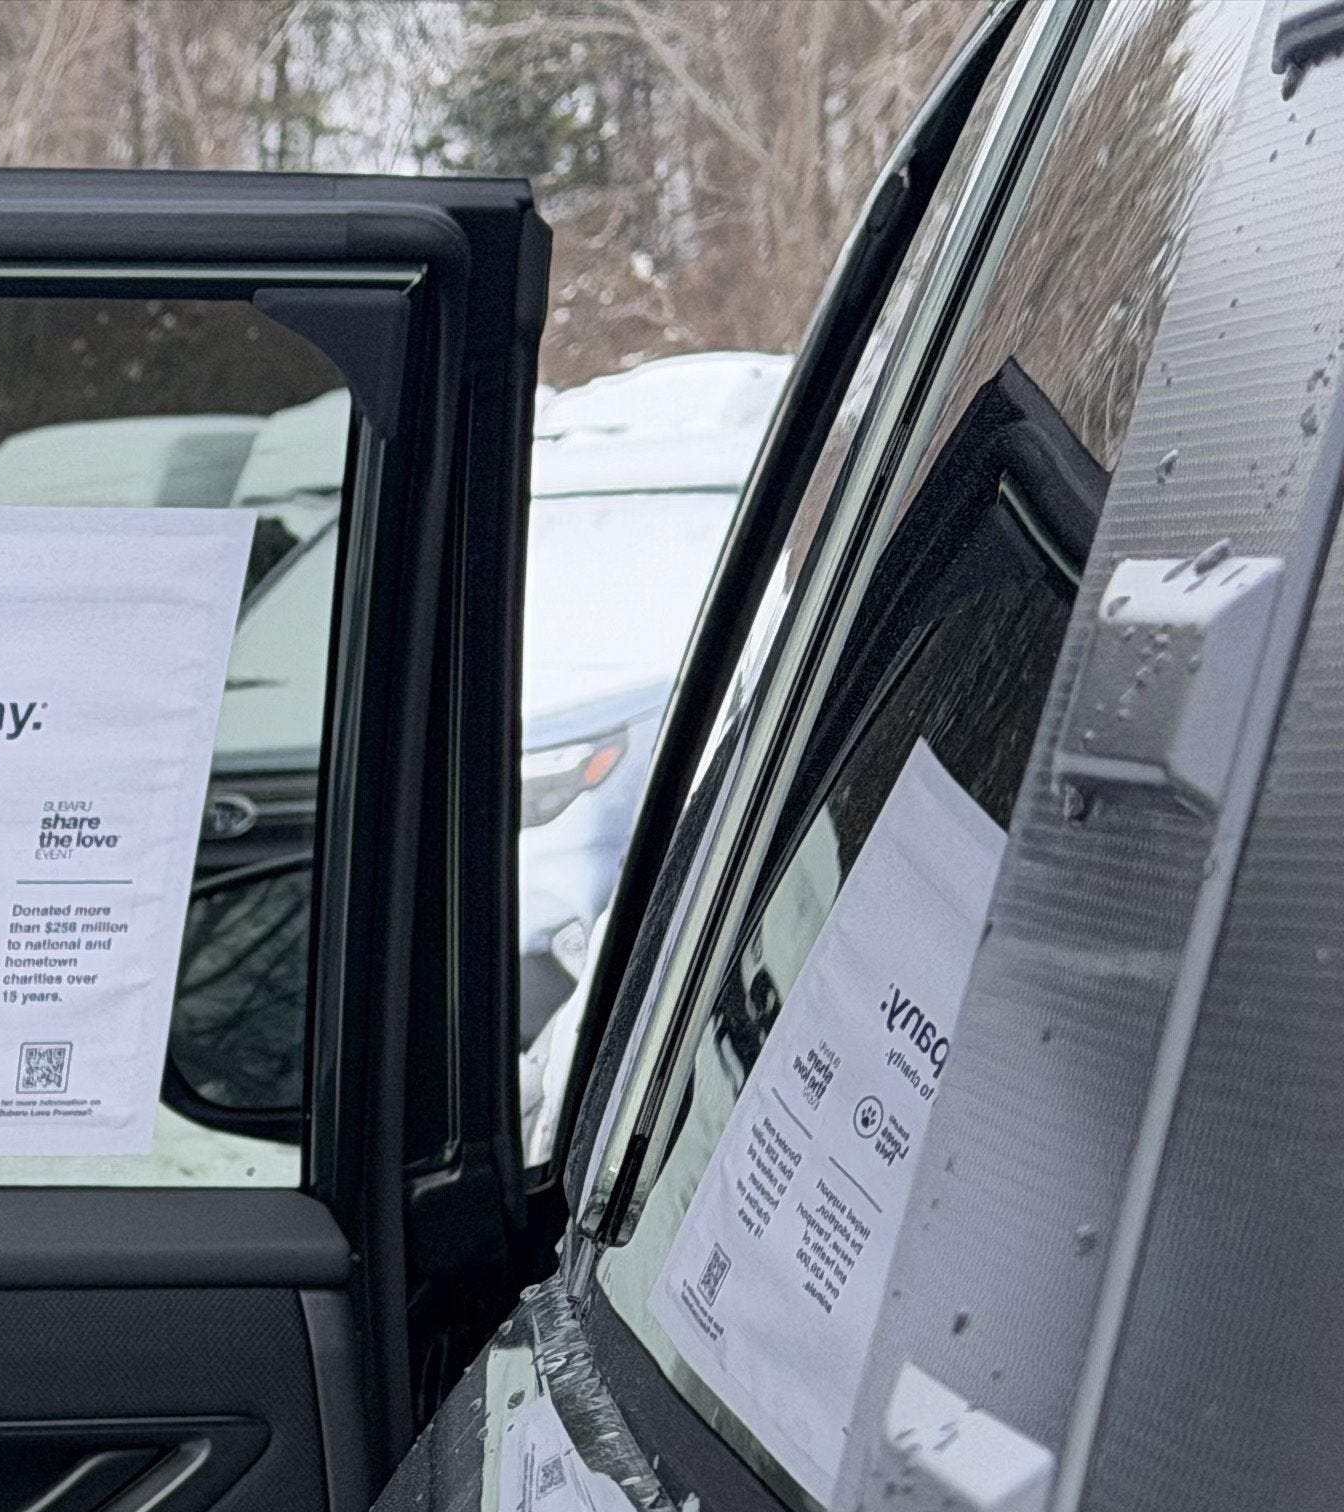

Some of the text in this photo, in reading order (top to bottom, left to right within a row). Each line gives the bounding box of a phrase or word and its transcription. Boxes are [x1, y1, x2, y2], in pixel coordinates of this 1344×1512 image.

[41, 813, 100, 832] share
[39, 831, 72, 849] the
[12, 904, 111, 917] Donated more
[10, 922, 40, 933] than
[81, 921, 128, 933] million
[8, 938, 112, 950] to national and
[5, 956, 77, 967] hometown
[3, 973, 98, 985] charities over
[22, 992, 62, 1005] years.
